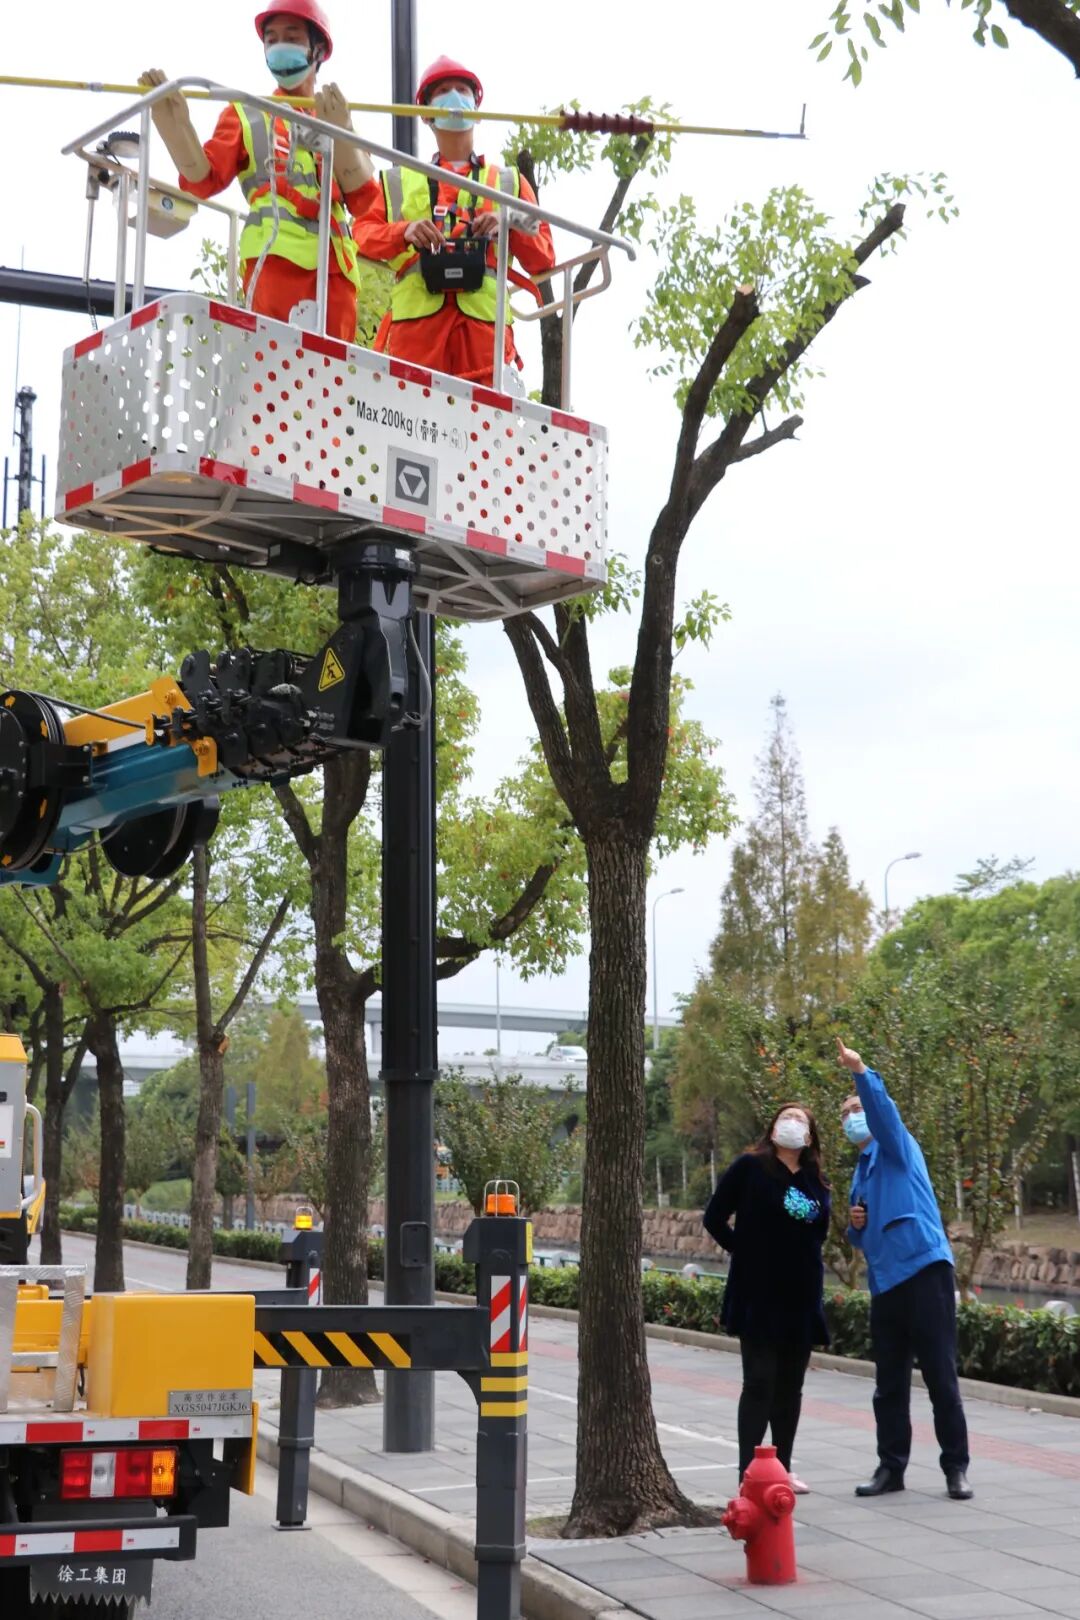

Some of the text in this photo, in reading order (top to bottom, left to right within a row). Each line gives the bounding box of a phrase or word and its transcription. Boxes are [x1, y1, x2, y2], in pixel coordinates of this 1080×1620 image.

[357, 400, 379, 423] Max
[381, 407, 413, 437] 200kg
[183, 1392, 239, 1402] 高空作业车
[57, 1564, 127, 1585] 徐工集团
